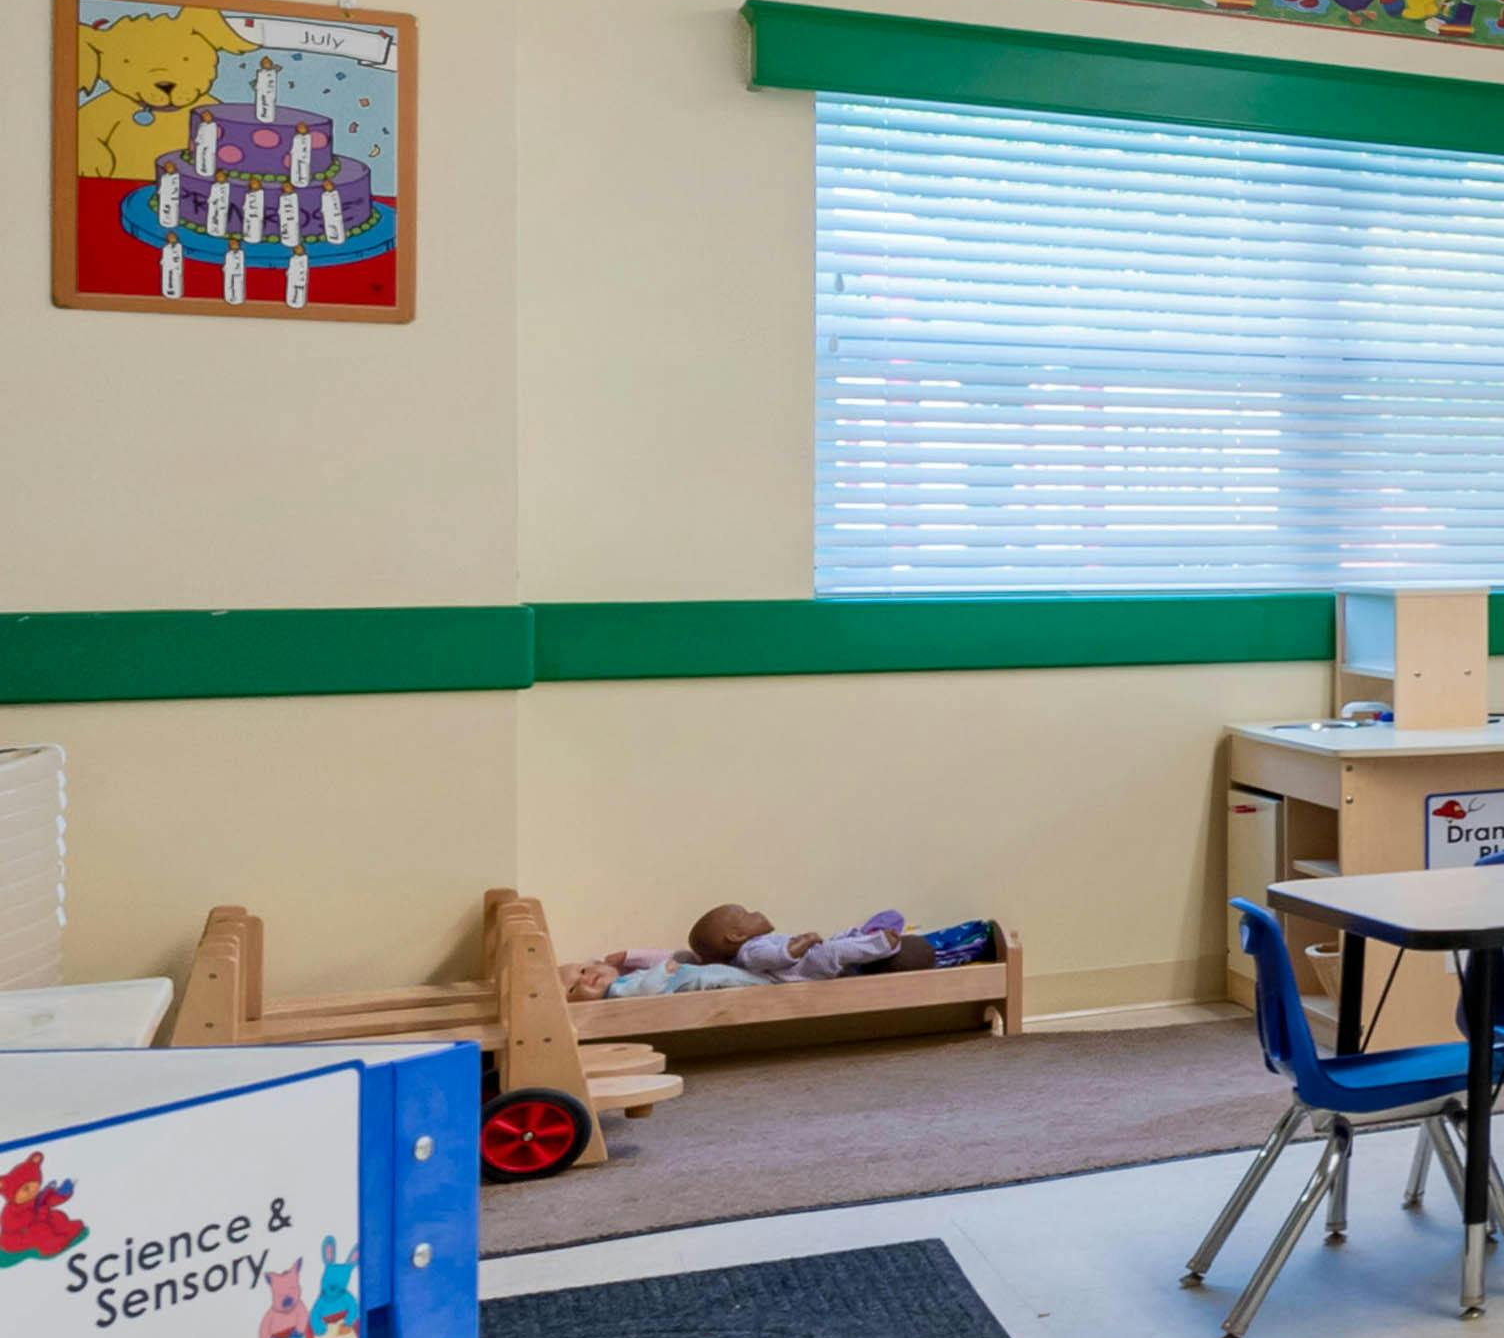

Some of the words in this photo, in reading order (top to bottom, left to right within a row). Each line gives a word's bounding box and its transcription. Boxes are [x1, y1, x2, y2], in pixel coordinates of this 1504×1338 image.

[66, 1215, 250, 1293] Science
[267, 1197, 293, 1232] &
[95, 1249, 270, 1328] Sensory
